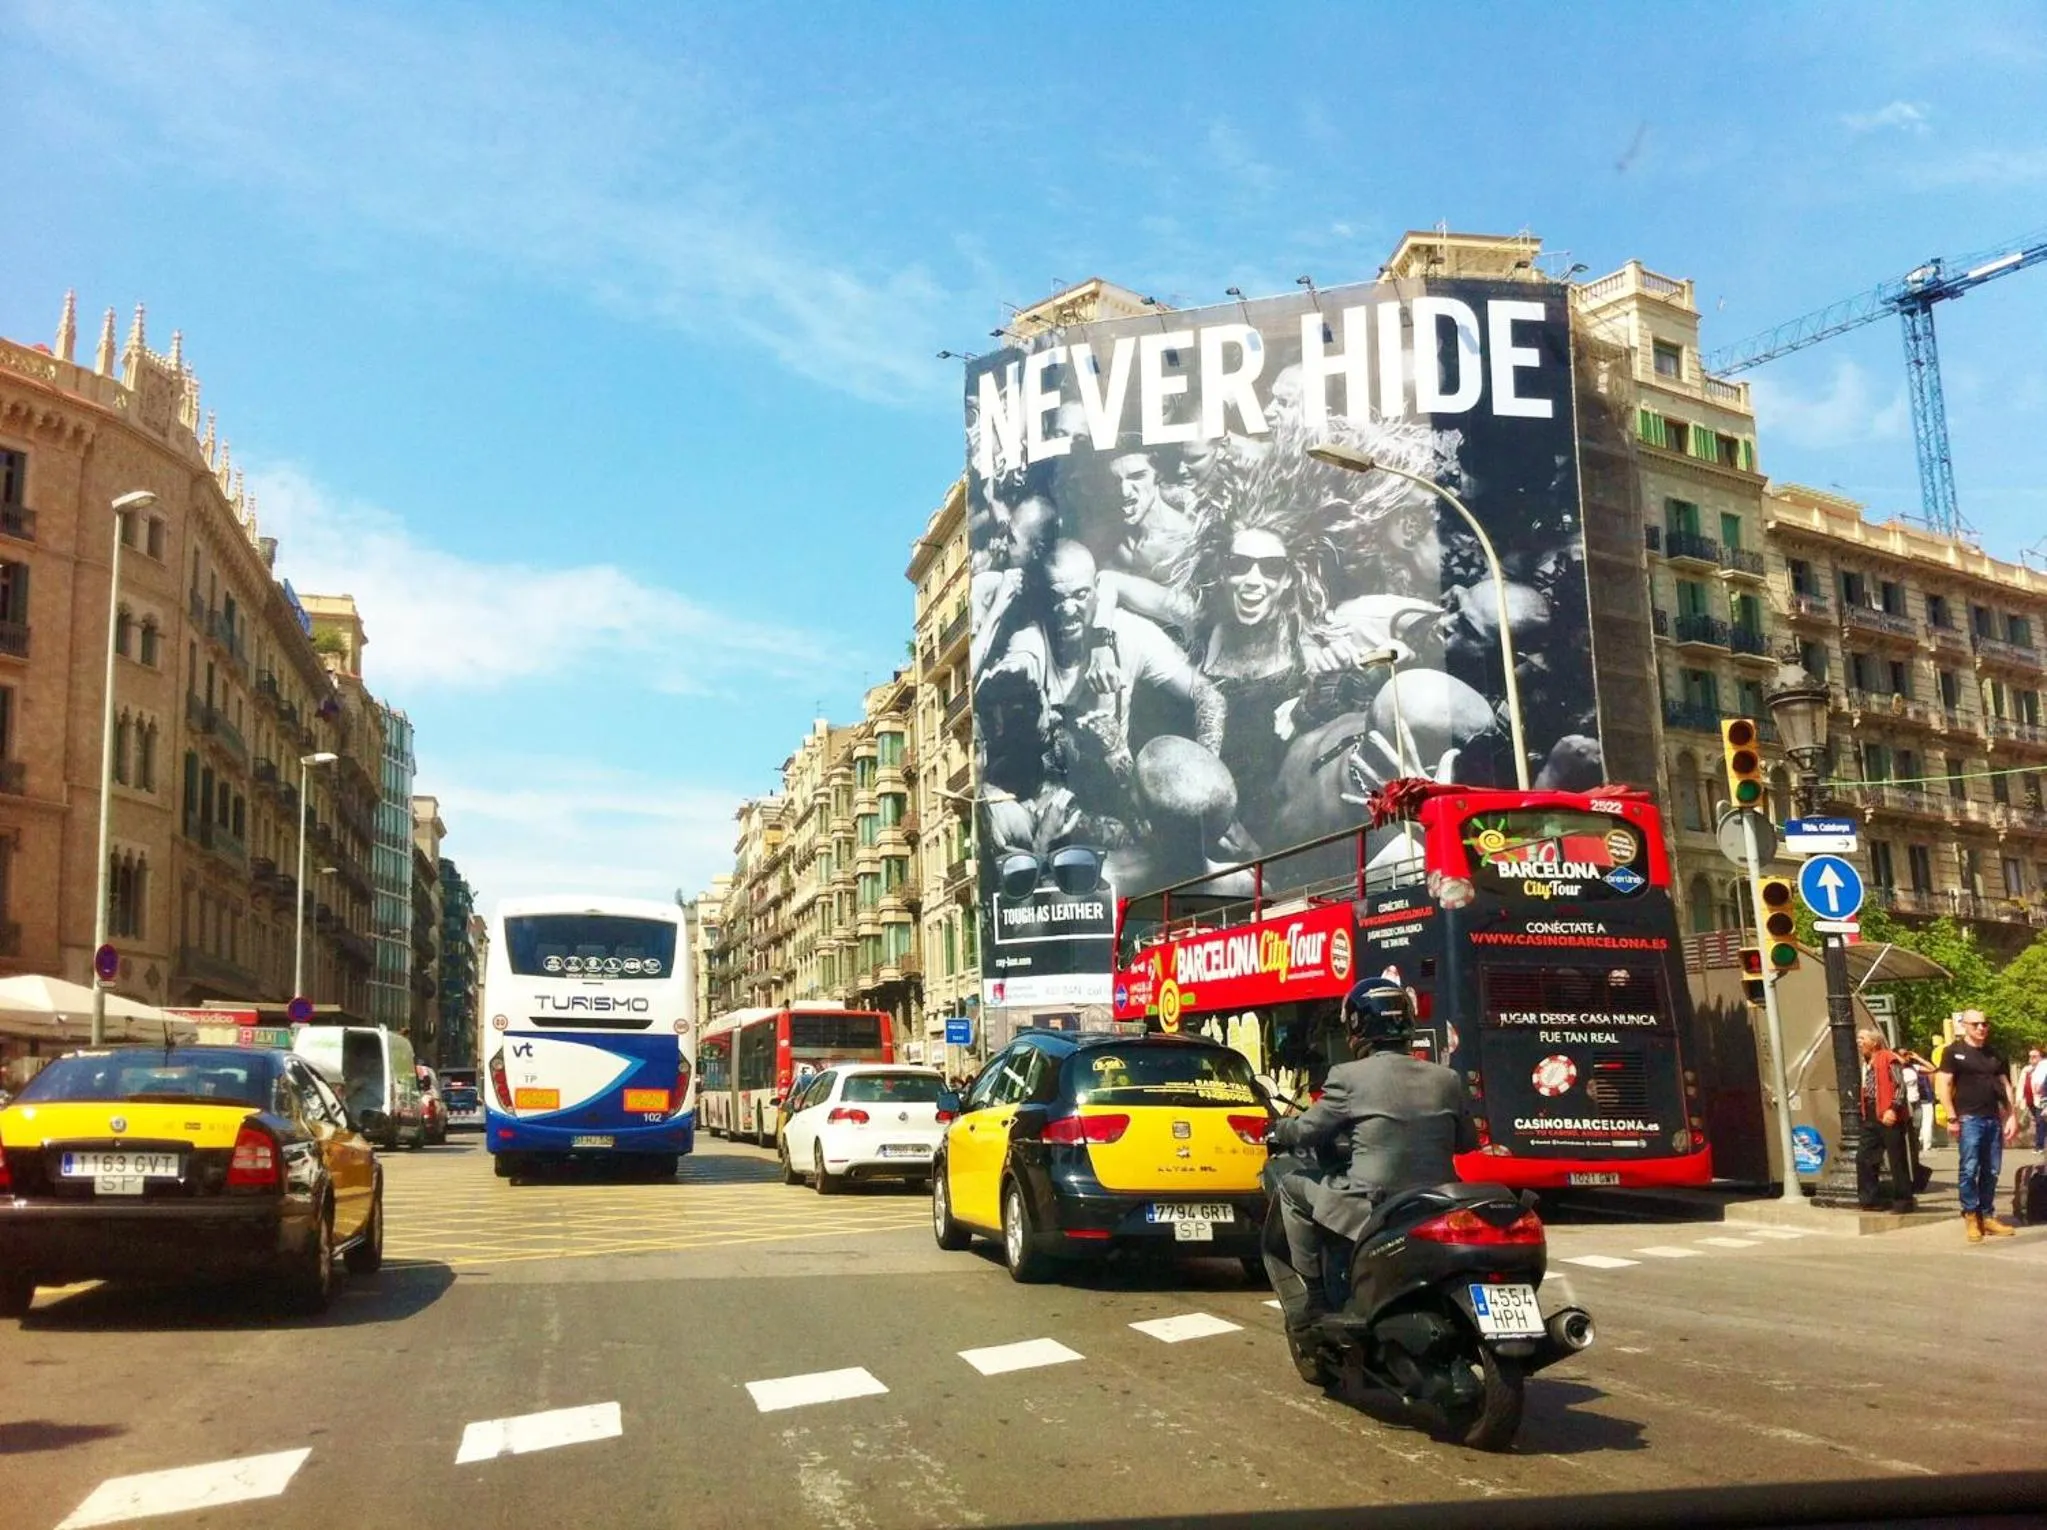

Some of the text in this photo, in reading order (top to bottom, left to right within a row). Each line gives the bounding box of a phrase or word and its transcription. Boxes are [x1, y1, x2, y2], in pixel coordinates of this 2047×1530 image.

[980, 296, 1554, 480] NEVER HIDE
[1590, 800, 1623, 815] 2522
[1498, 862, 1600, 879] BARCELONA
[1003, 902, 1104, 925] TOUGH AS LEATHER
[1526, 920, 1607, 934] CONÉCTATE A
[1470, 933, 1668, 949] WWW.CASINOBARCELONA.ES
[1177, 932, 1260, 984] BARCELONA
[534, 995, 649, 1012] TURISMO
[1500, 1013, 1657, 1027] JUGAR DESDE CASA NUNCA
[1540, 1031, 1619, 1043] FUE TAN REAL
[643, 1113, 662, 1122] 102
[1514, 1118, 1660, 1131] CASINOBARCELONA.es
[78, 1155, 172, 1173] 1163 GVT
[101, 1176, 138, 1191] SP
[1156, 1205, 1230, 1220] 7794 GRT
[1180, 1223, 1207, 1238] SP
[1489, 1288, 1533, 1307] 4554
[1493, 1309, 1529, 1328] HPH
